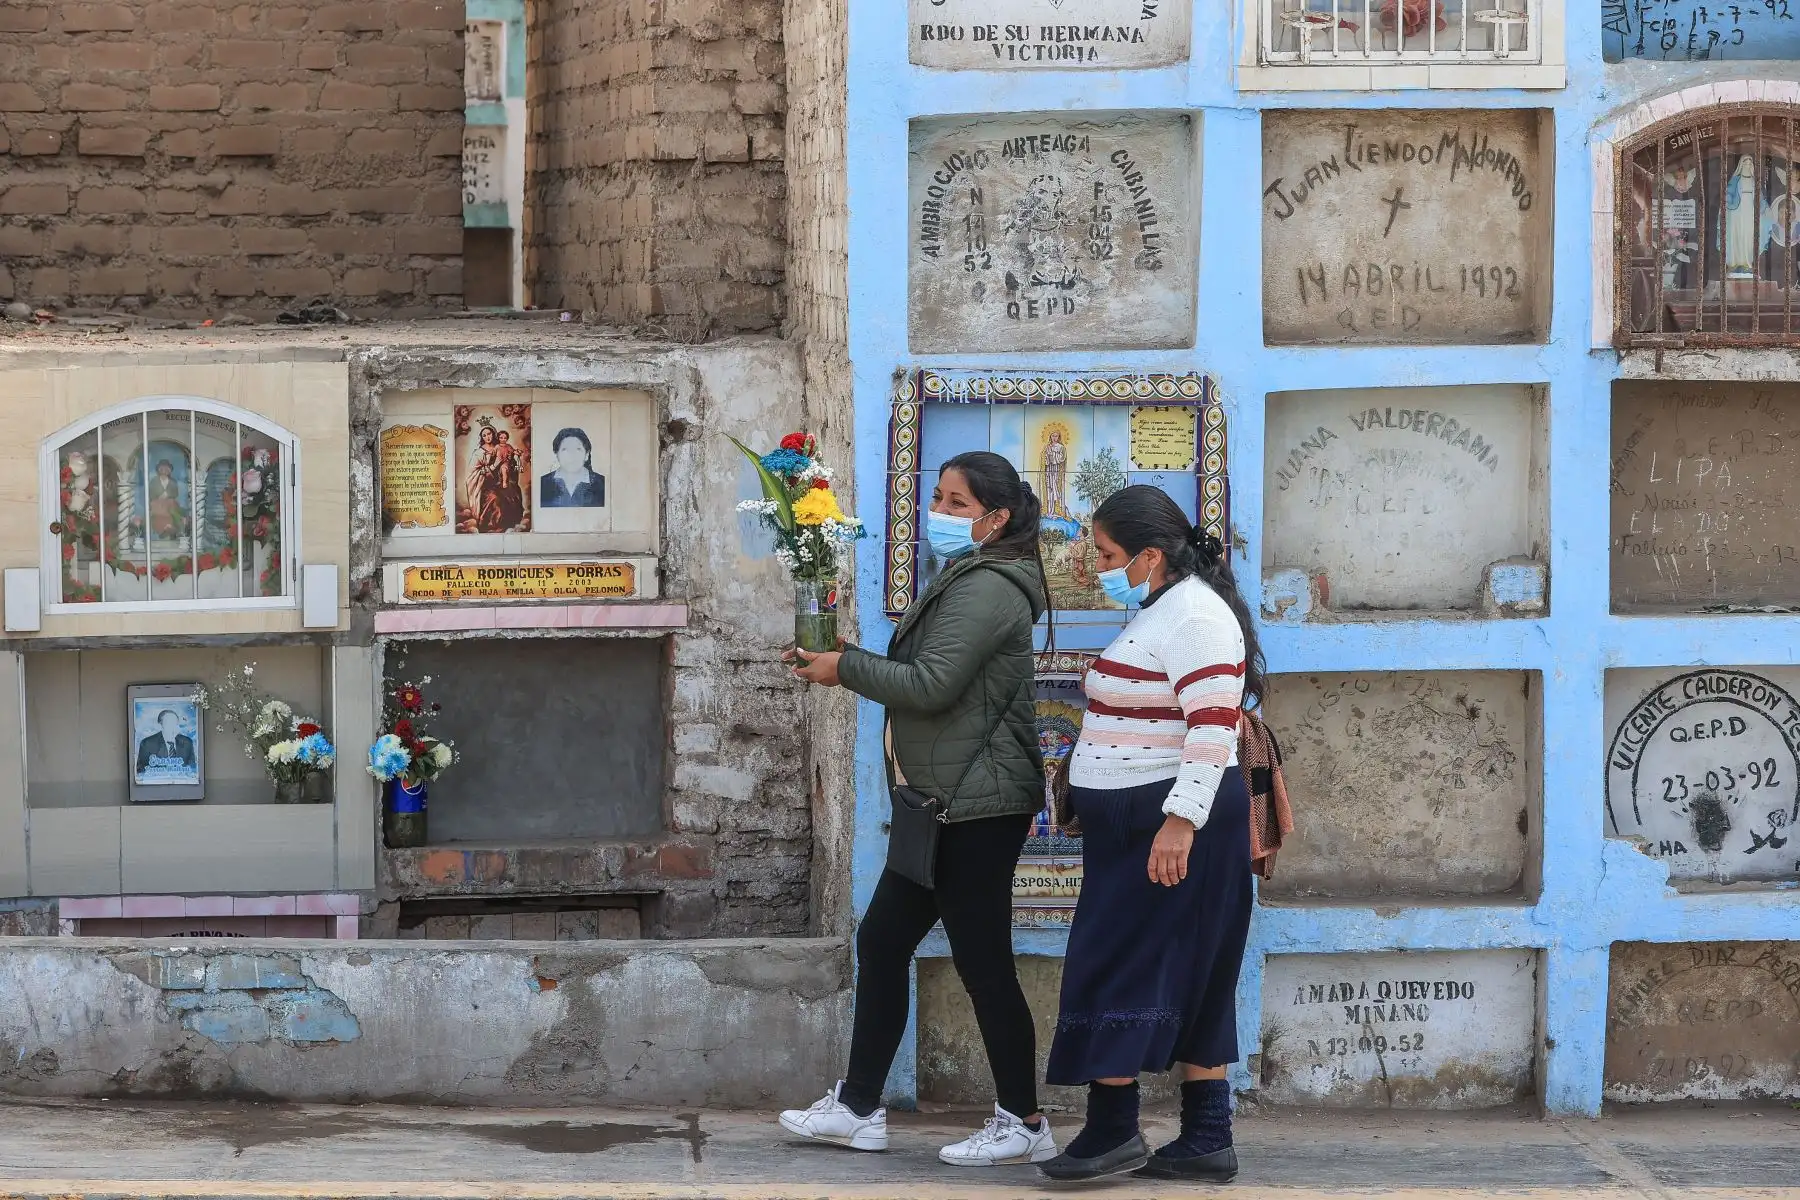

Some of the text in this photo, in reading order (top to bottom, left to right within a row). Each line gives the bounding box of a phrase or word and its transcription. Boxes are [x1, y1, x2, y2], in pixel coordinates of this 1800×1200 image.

[920, 24, 1144, 43] RDO DE SU HERMANA
[992, 43, 1099, 62] VICTORIA
[1001, 133, 1091, 159] ARTEAGA
[970, 187, 983, 206] N
[1093, 181, 1104, 201] F
[1263, 155, 1341, 221] JUAN
[1089, 204, 1113, 222] 15
[963, 252, 992, 273] 52
[1298, 262, 1328, 308] 14
[1459, 262, 1520, 301] 1992
[165, 413, 206, 424] RECUEDO
[1274, 425, 1339, 492] JUANA
[1347, 406, 1500, 474] VALDERRAMA
[420, 566, 622, 581] CIRILA RODRIGUES PORRAS
[442, 589, 454, 597] DE
[461, 589, 472, 597] SU
[479, 589, 499, 597] HIJA
[506, 588, 534, 596] EMILIA
[540, 587, 547, 595] Y
[447, 580, 491, 589] FALLECIO
[1612, 690, 1676, 770] VICENTE
[1661, 757, 1780, 803] 23-03-92
[1292, 980, 1476, 1006] AMADA QUEVEDO
